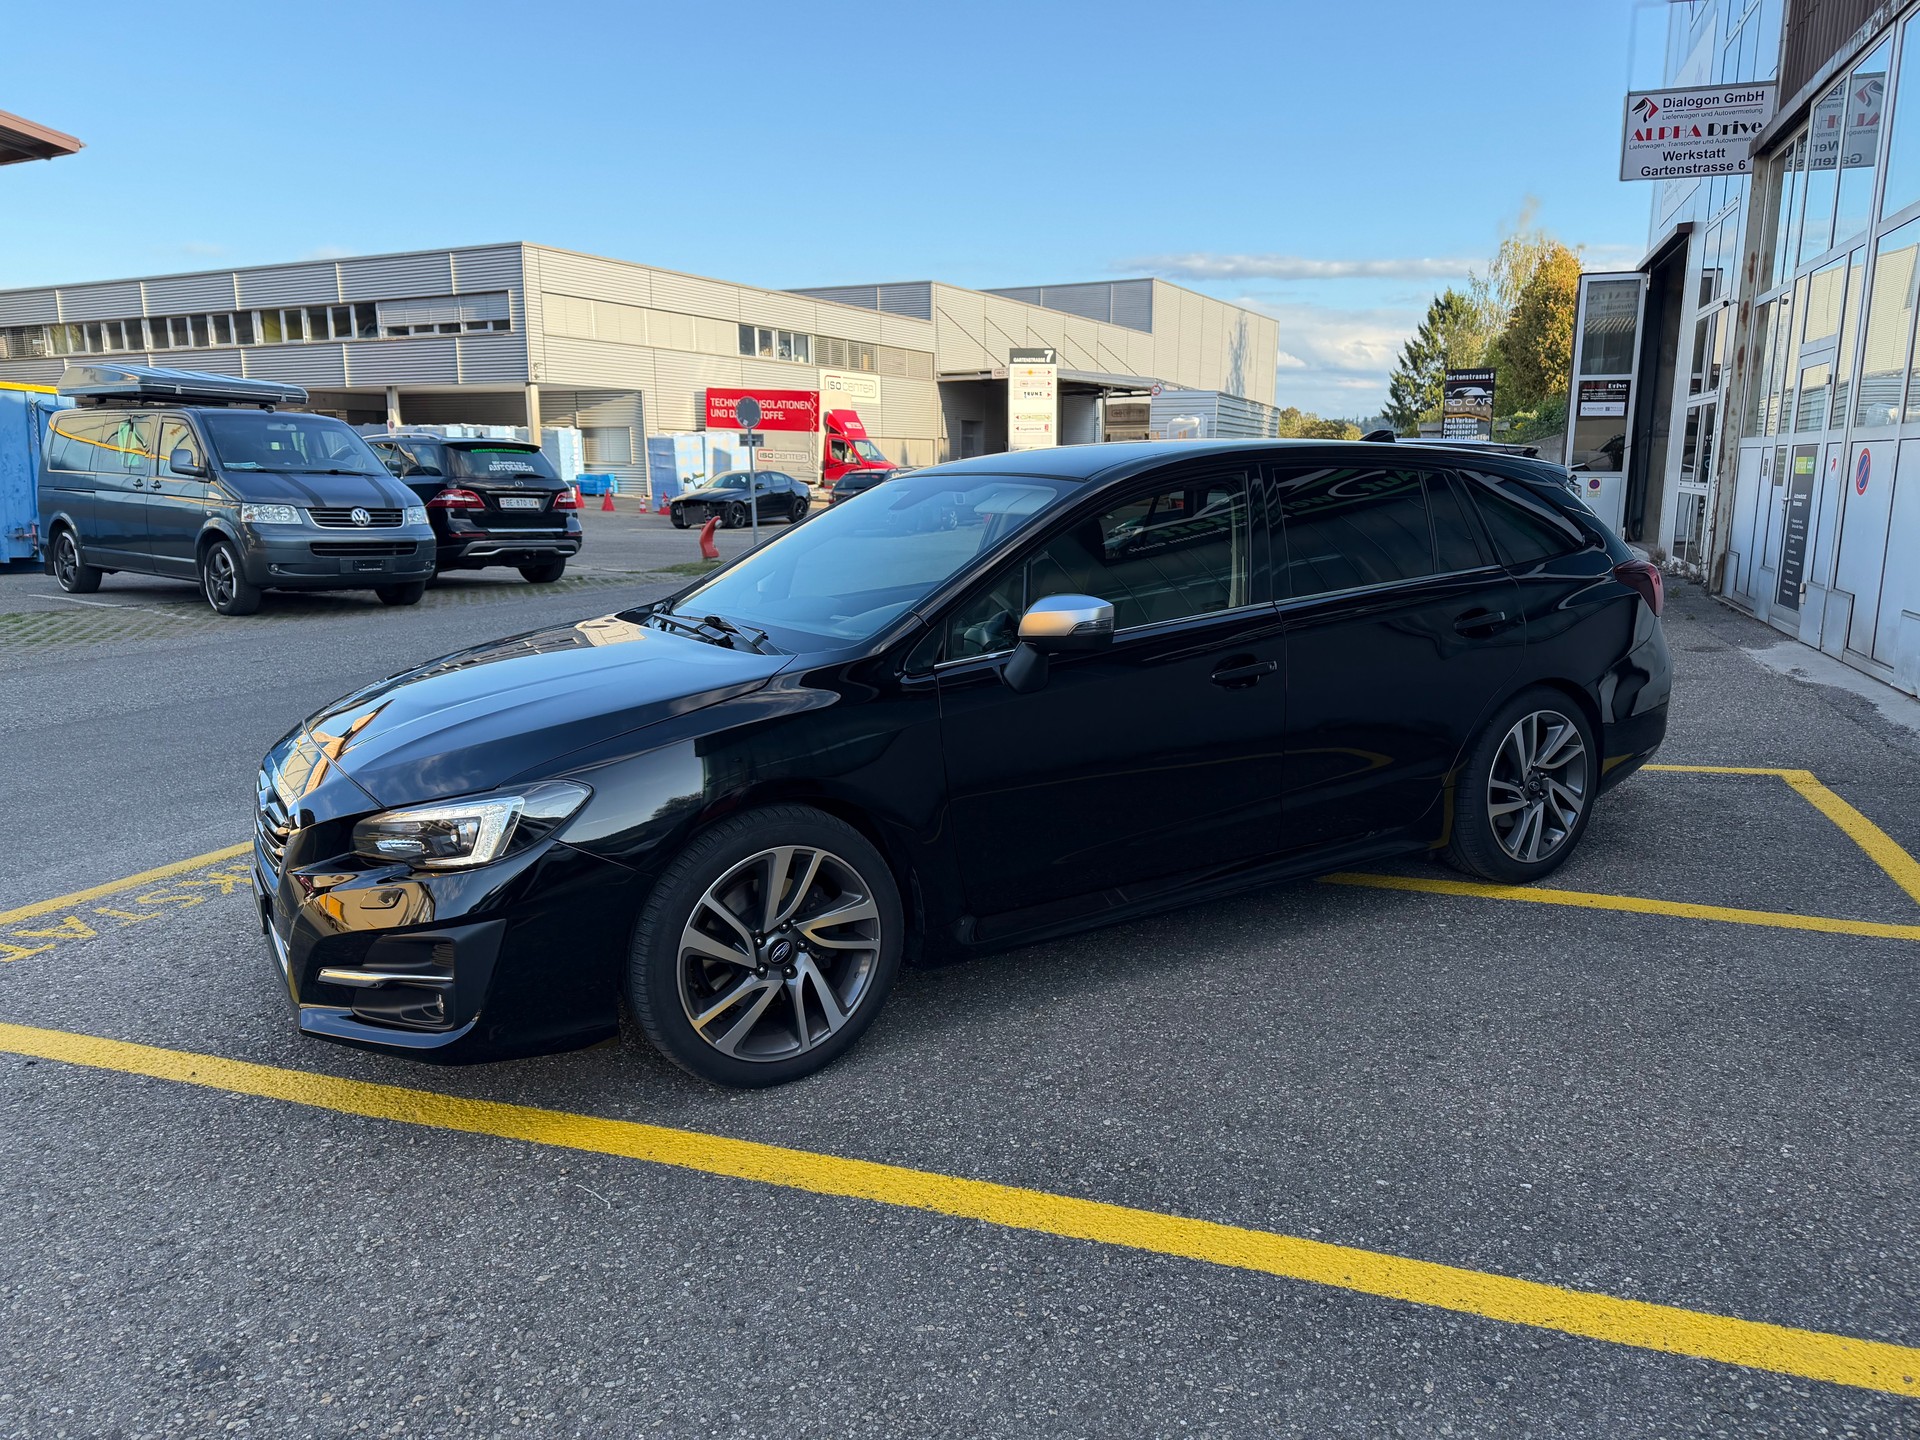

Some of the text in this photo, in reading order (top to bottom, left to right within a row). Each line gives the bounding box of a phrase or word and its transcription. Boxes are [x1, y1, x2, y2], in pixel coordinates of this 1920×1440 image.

[1663, 90, 1764, 109] Dialogon GmbH
[1662, 107, 1763, 121] Lieferwagen und Autovermietung
[1629, 121, 1763, 143] ALPHA Drive
[1668, 139, 1701, 148] Transporter
[1662, 148, 1726, 162] Werkstatt
[1641, 160, 1746, 177] Gartenstrasse 6
[1044, 350, 1054, 363] 7
[1446, 372, 1494, 381] Gartenstrasse 8
[828, 380, 842, 391] ISO
[759, 399, 811, 411] ISOLATIONEN
[1465, 397, 1493, 406] CAR
[710, 408, 728, 418] UND
